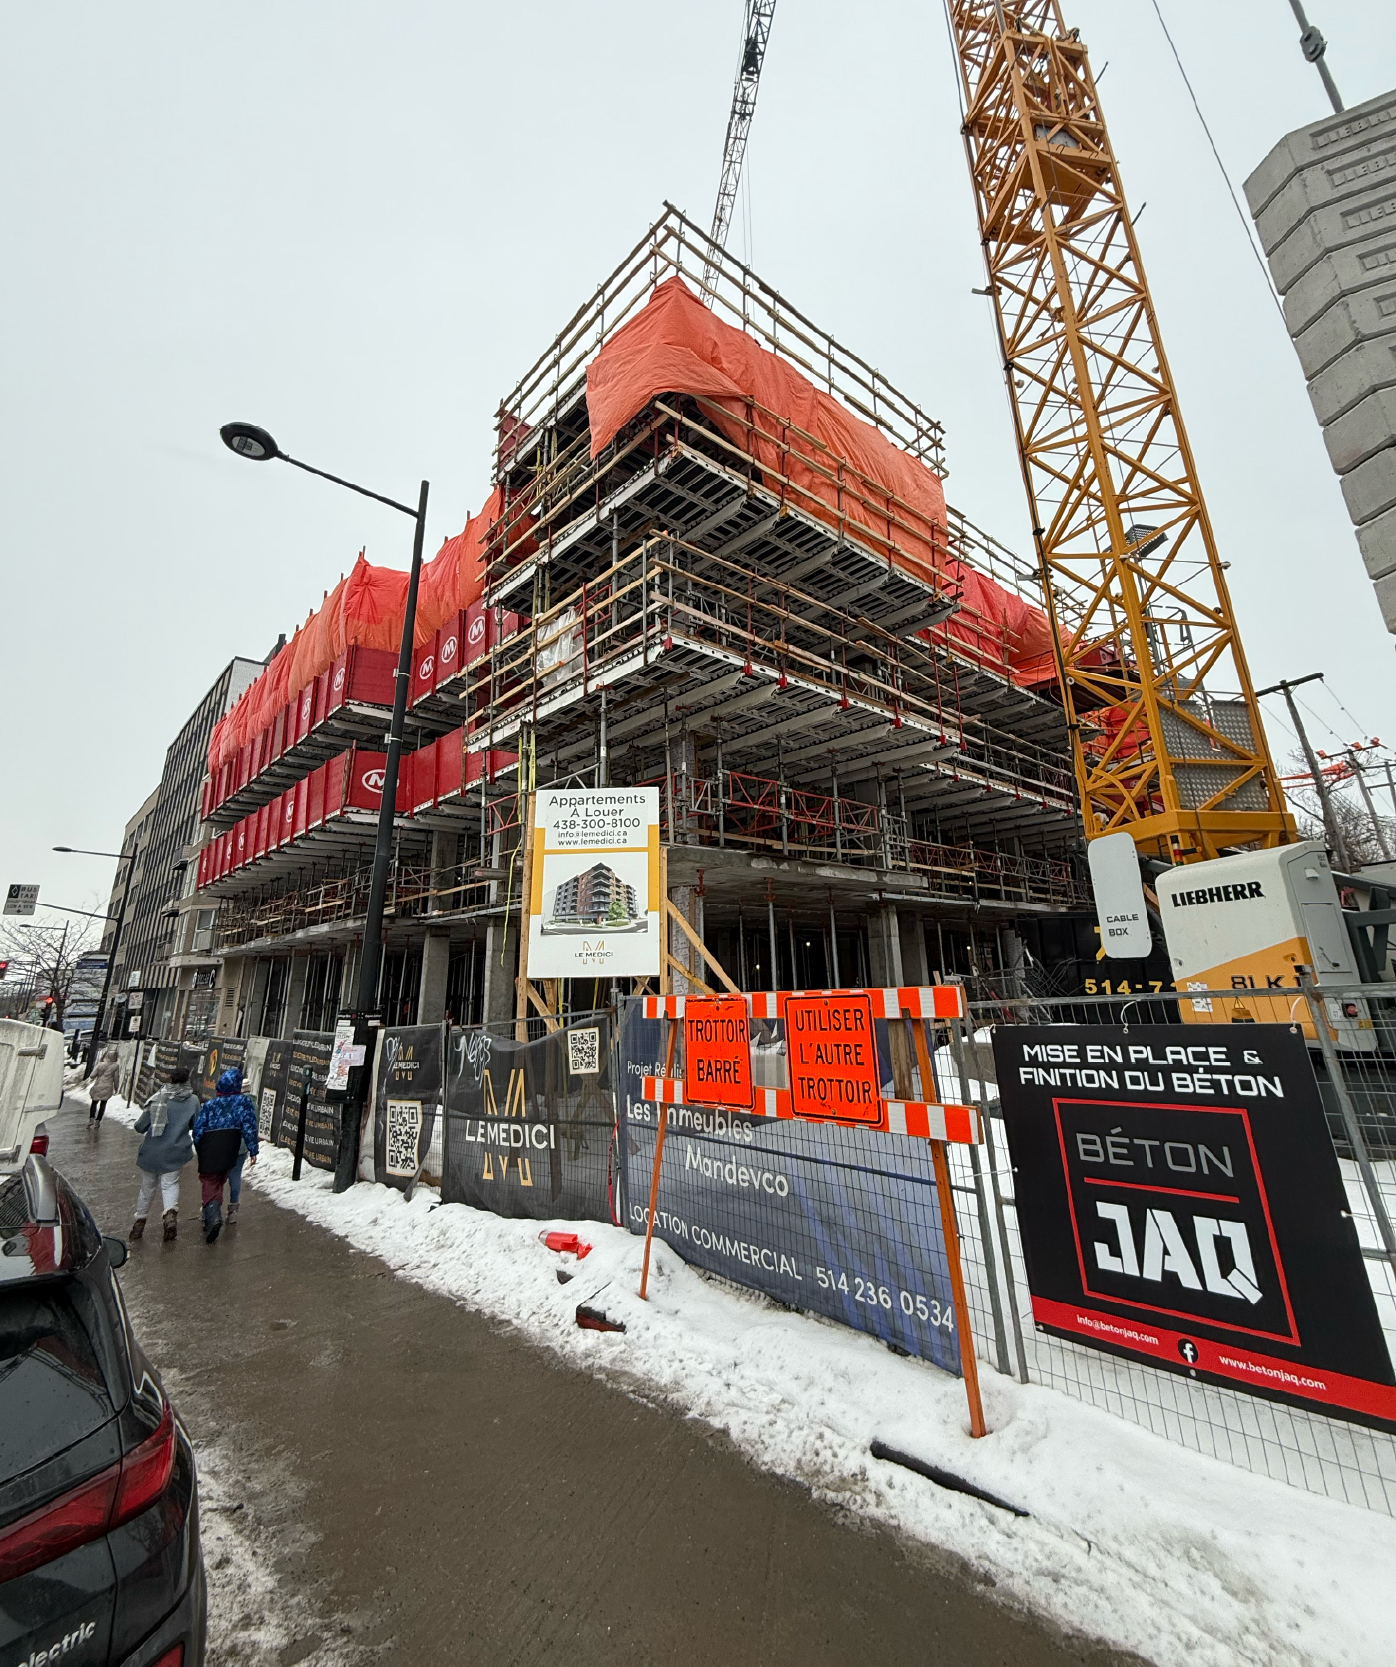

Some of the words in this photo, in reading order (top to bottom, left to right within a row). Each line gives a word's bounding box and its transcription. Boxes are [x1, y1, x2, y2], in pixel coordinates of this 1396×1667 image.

[549, 794, 646, 808] Appartements
[585, 807, 624, 817] Louer
[553, 818, 640, 829] 438-300-8100
[558, 830, 627, 838] info@lemedici.ca
[558, 837, 627, 846] www.lemedici.ca
[1171, 881, 1266, 907] LIEBHERR
[1106, 914, 1139, 923] CABLE
[1108, 928, 1129, 937] BOX
[688, 1019, 747, 1043] TROTTOIR
[794, 1008, 865, 1032] UTILISER
[800, 1042, 866, 1066] L'AUTRE
[1023, 1044, 1079, 1063] MISE
[1086, 1045, 1122, 1064] EN
[1130, 1047, 1231, 1067] PLACE
[627, 1060, 652, 1079] Projet
[697, 1056, 741, 1084] BARRÉ
[799, 1077, 873, 1104] TROTTOIR
[1019, 1067, 1120, 1090] FINITION
[1126, 1069, 1165, 1091] DU
[1172, 1067, 1284, 1098] BÉTON
[627, 1094, 651, 1121] Les
[465, 1119, 555, 1149] LEMEDICI
[1076, 1127, 1234, 1178] BÉTON
[686, 1145, 789, 1197] Mandevco
[1093, 1201, 1263, 1305] JAQ
[630, 1202, 689, 1240] LOCATION
[691, 1225, 803, 1281] COMMERCIAL
[816, 1266, 850, 1295] 514
[854, 1277, 892, 1309] 236
[900, 1290, 954, 1333] 0534
[1077, 1314, 1159, 1346] info@betonjaq.com
[1219, 1355, 1327, 1391] www.betonjaq.com
